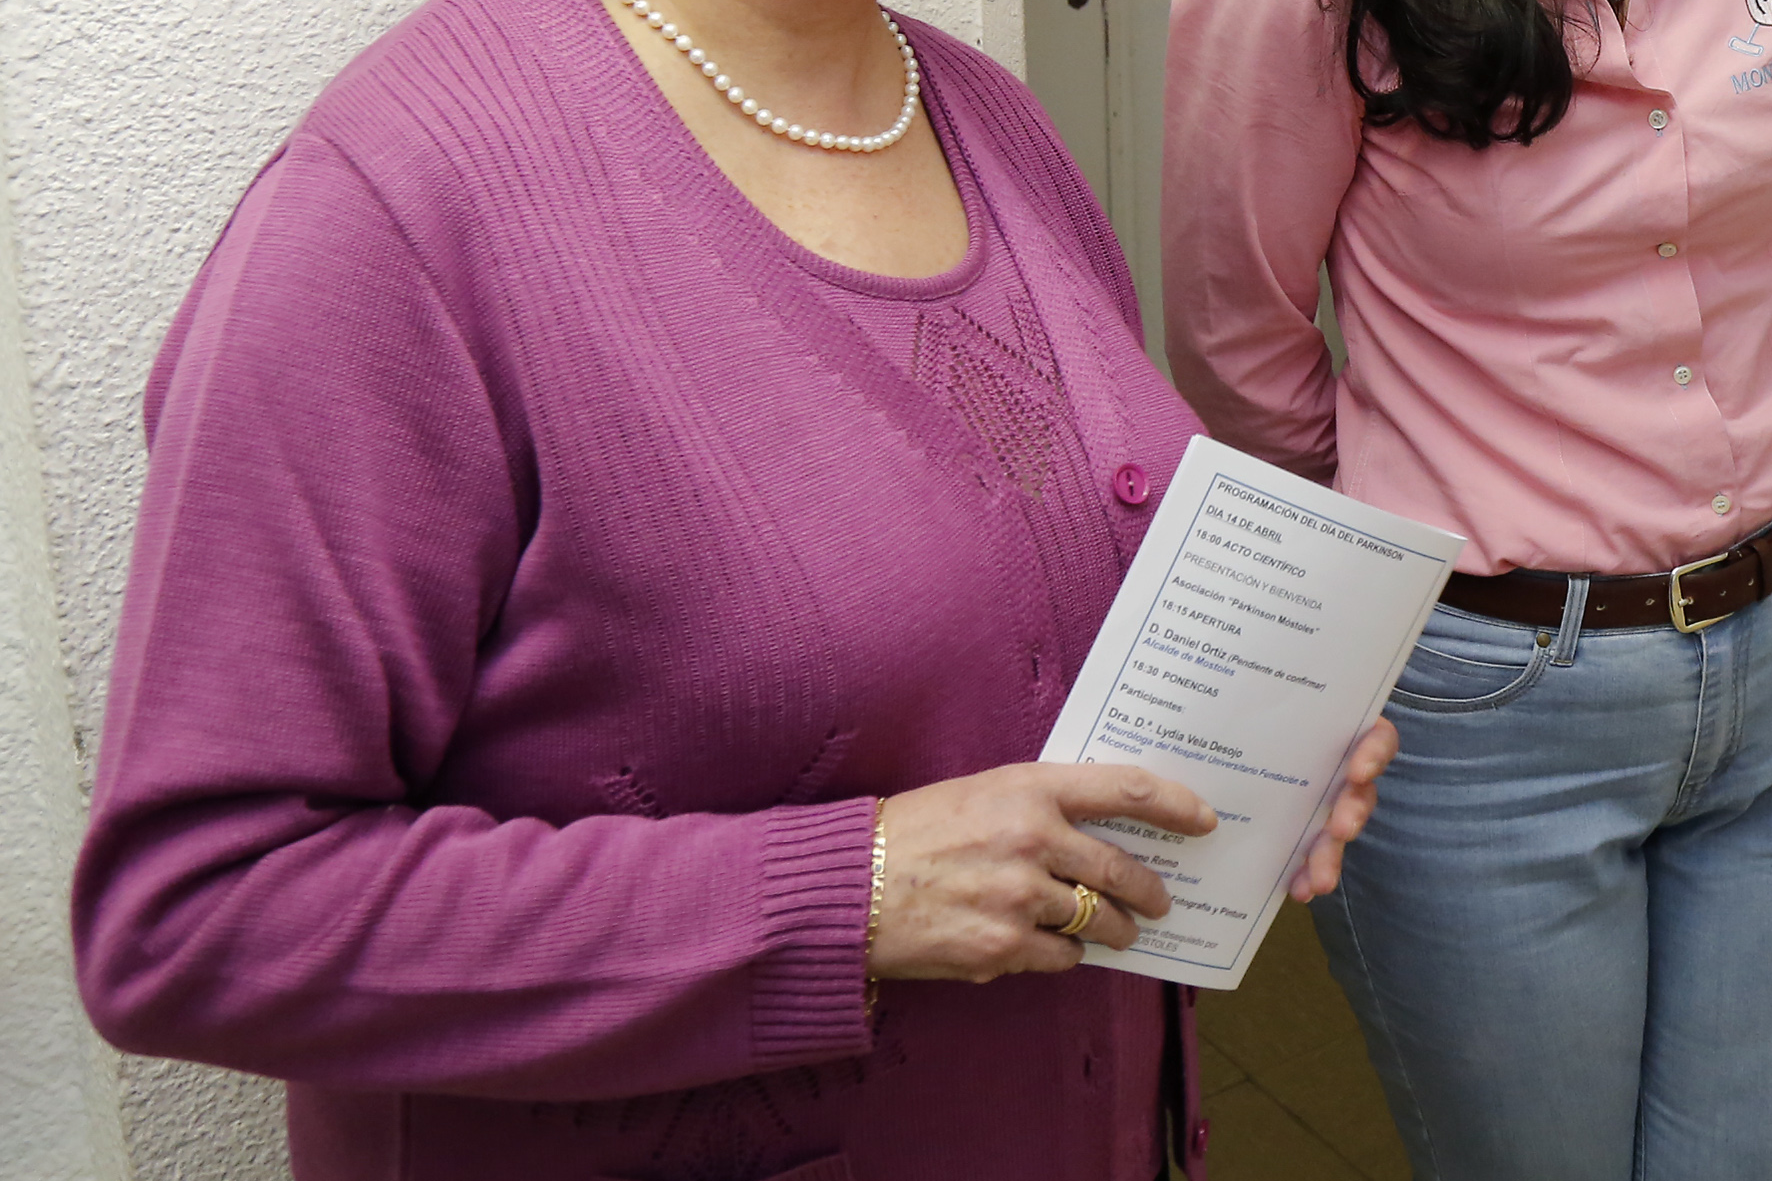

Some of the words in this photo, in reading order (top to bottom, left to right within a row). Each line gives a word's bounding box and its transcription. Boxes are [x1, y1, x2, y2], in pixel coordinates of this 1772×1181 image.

[1217, 481, 1300, 521] PROGRAMACIÓN
[1300, 515, 1318, 529] DEL
[1337, 530, 1354, 545] DEL
[1356, 538, 1405, 561] PARKINSON
[1227, 513, 1239, 524] 14
[1239, 518, 1254, 531] DE
[1254, 525, 1283, 544] ABRIL
[1196, 529, 1222, 545] 18:00
[1223, 540, 1252, 557] ACTO
[1253, 552, 1307, 578] CIENTÍFICO
[1171, 576, 1225, 603] Asociación
[1183, 551, 1261, 589] PRESENTACIÓN
[1262, 582, 1270, 591] Y
[1269, 585, 1322, 610] BIENVENIDA
[1161, 599, 1189, 617] 18:15
[1188, 610, 1242, 636] APERTURA
[1142, 637, 1180, 657] Alcalde
[1180, 651, 1194, 662] de
[1149, 622, 1160, 636] D.
[1163, 628, 1200, 650] Daniel
[1201, 642, 1228, 660] Ortiz
[1228, 654, 1274, 676] (Pendiente
[1274, 669, 1286, 679] de
[1286, 673, 1328, 693] confirmar)
[1132, 660, 1159, 677] 18:30
[1162, 671, 1220, 698] PONENCIAS
[1119, 682, 1187, 714] Participantes:
[1097, 733, 1143, 756] Alcorcón
[1108, 707, 1131, 725] Dra.
[1156, 724, 1185, 742] Lydia
[1187, 733, 1208, 749] Vela
[1208, 740, 1243, 759] Desojo
[1155, 740, 1170, 751] del
[1170, 744, 1208, 762] Hospital
[1207, 754, 1259, 776] Universitario
[1299, 778, 1310, 787] de
[1142, 829, 1159, 840] DEL
[1160, 833, 1185, 845] ACTO
[1150, 854, 1180, 869] Romo
[1175, 873, 1202, 886] Social
[1212, 907, 1219, 916] y
[1220, 906, 1248, 920] Pintura
